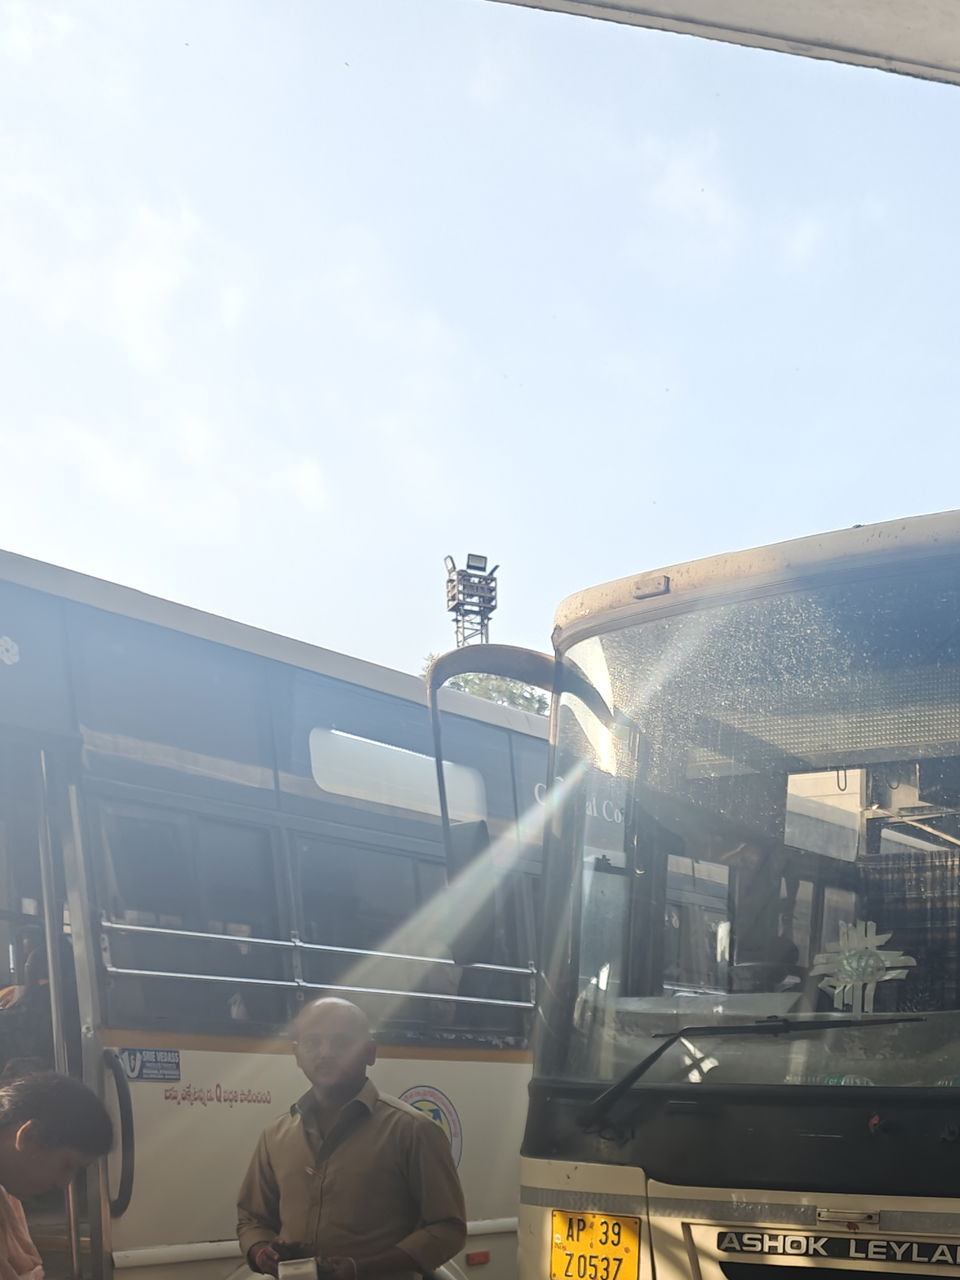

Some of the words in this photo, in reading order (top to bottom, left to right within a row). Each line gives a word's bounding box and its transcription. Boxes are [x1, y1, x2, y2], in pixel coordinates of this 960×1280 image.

[566, 1217, 586, 1242] AP
[599, 1220, 621, 1247] 39
[719, 1233, 829, 1257] ASHOK
